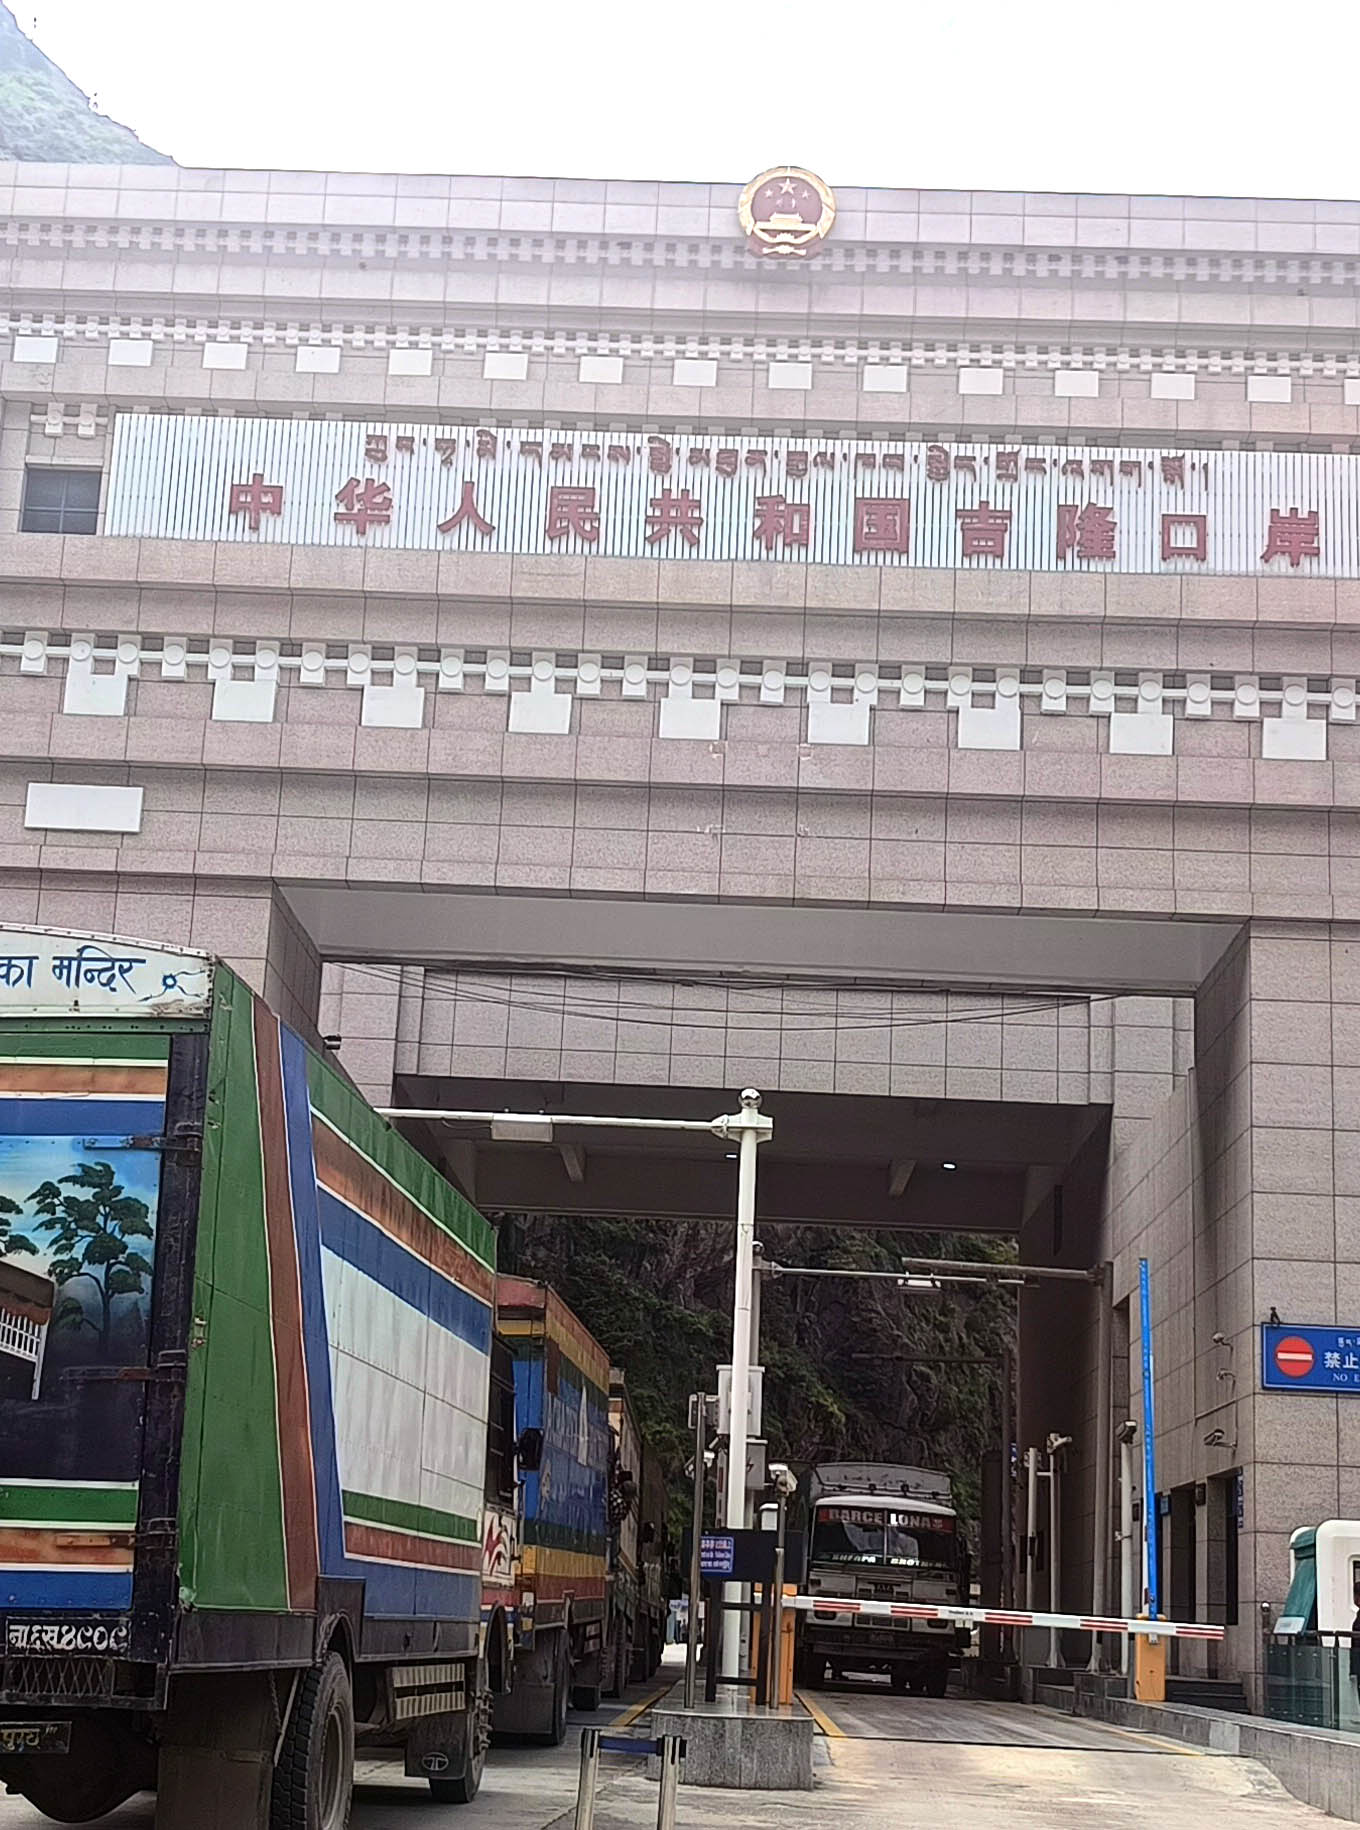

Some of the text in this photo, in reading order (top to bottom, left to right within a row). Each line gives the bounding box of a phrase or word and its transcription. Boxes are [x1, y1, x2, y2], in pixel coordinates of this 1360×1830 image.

[230, 472, 1321, 568] 中华人民共和国吉隆口岸
[52, 945, 147, 994] मन्दिर
[1333, 1373, 1348, 1382] NO
